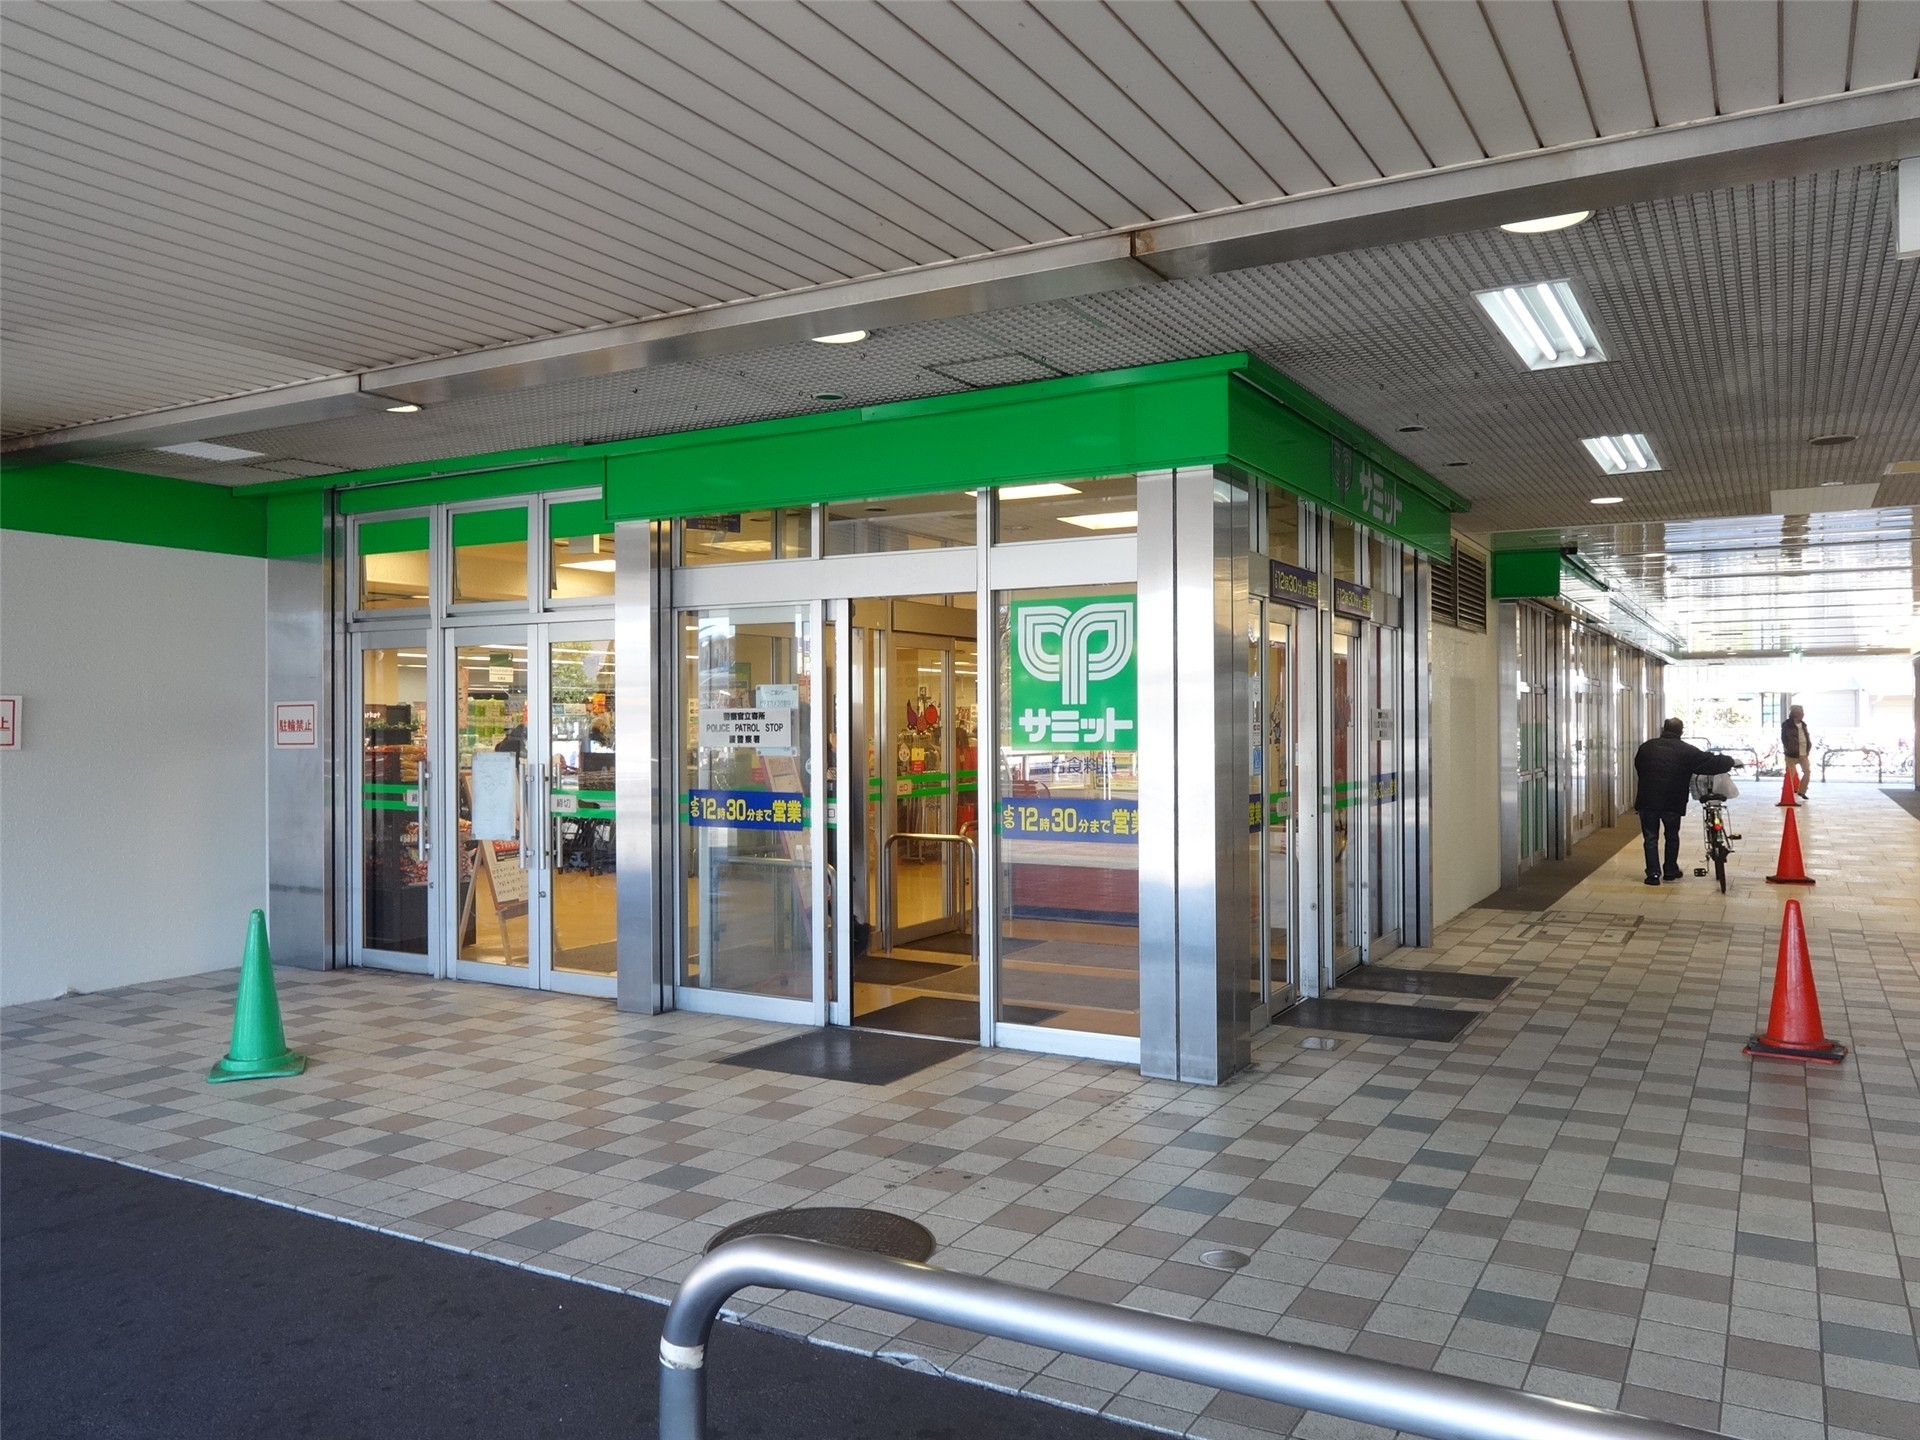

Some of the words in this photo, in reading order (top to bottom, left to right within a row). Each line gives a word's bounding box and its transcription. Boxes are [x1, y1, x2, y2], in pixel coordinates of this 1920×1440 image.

[1359, 460, 1403, 527] サミット
[279, 718, 312, 732] 駐輪禁止
[706, 723, 730, 732] POLICE
[735, 723, 760, 732] PATROL
[765, 723, 784, 732] STOP
[1019, 707, 1134, 743] サミット
[690, 795, 802, 824] よる12時30分まで営業
